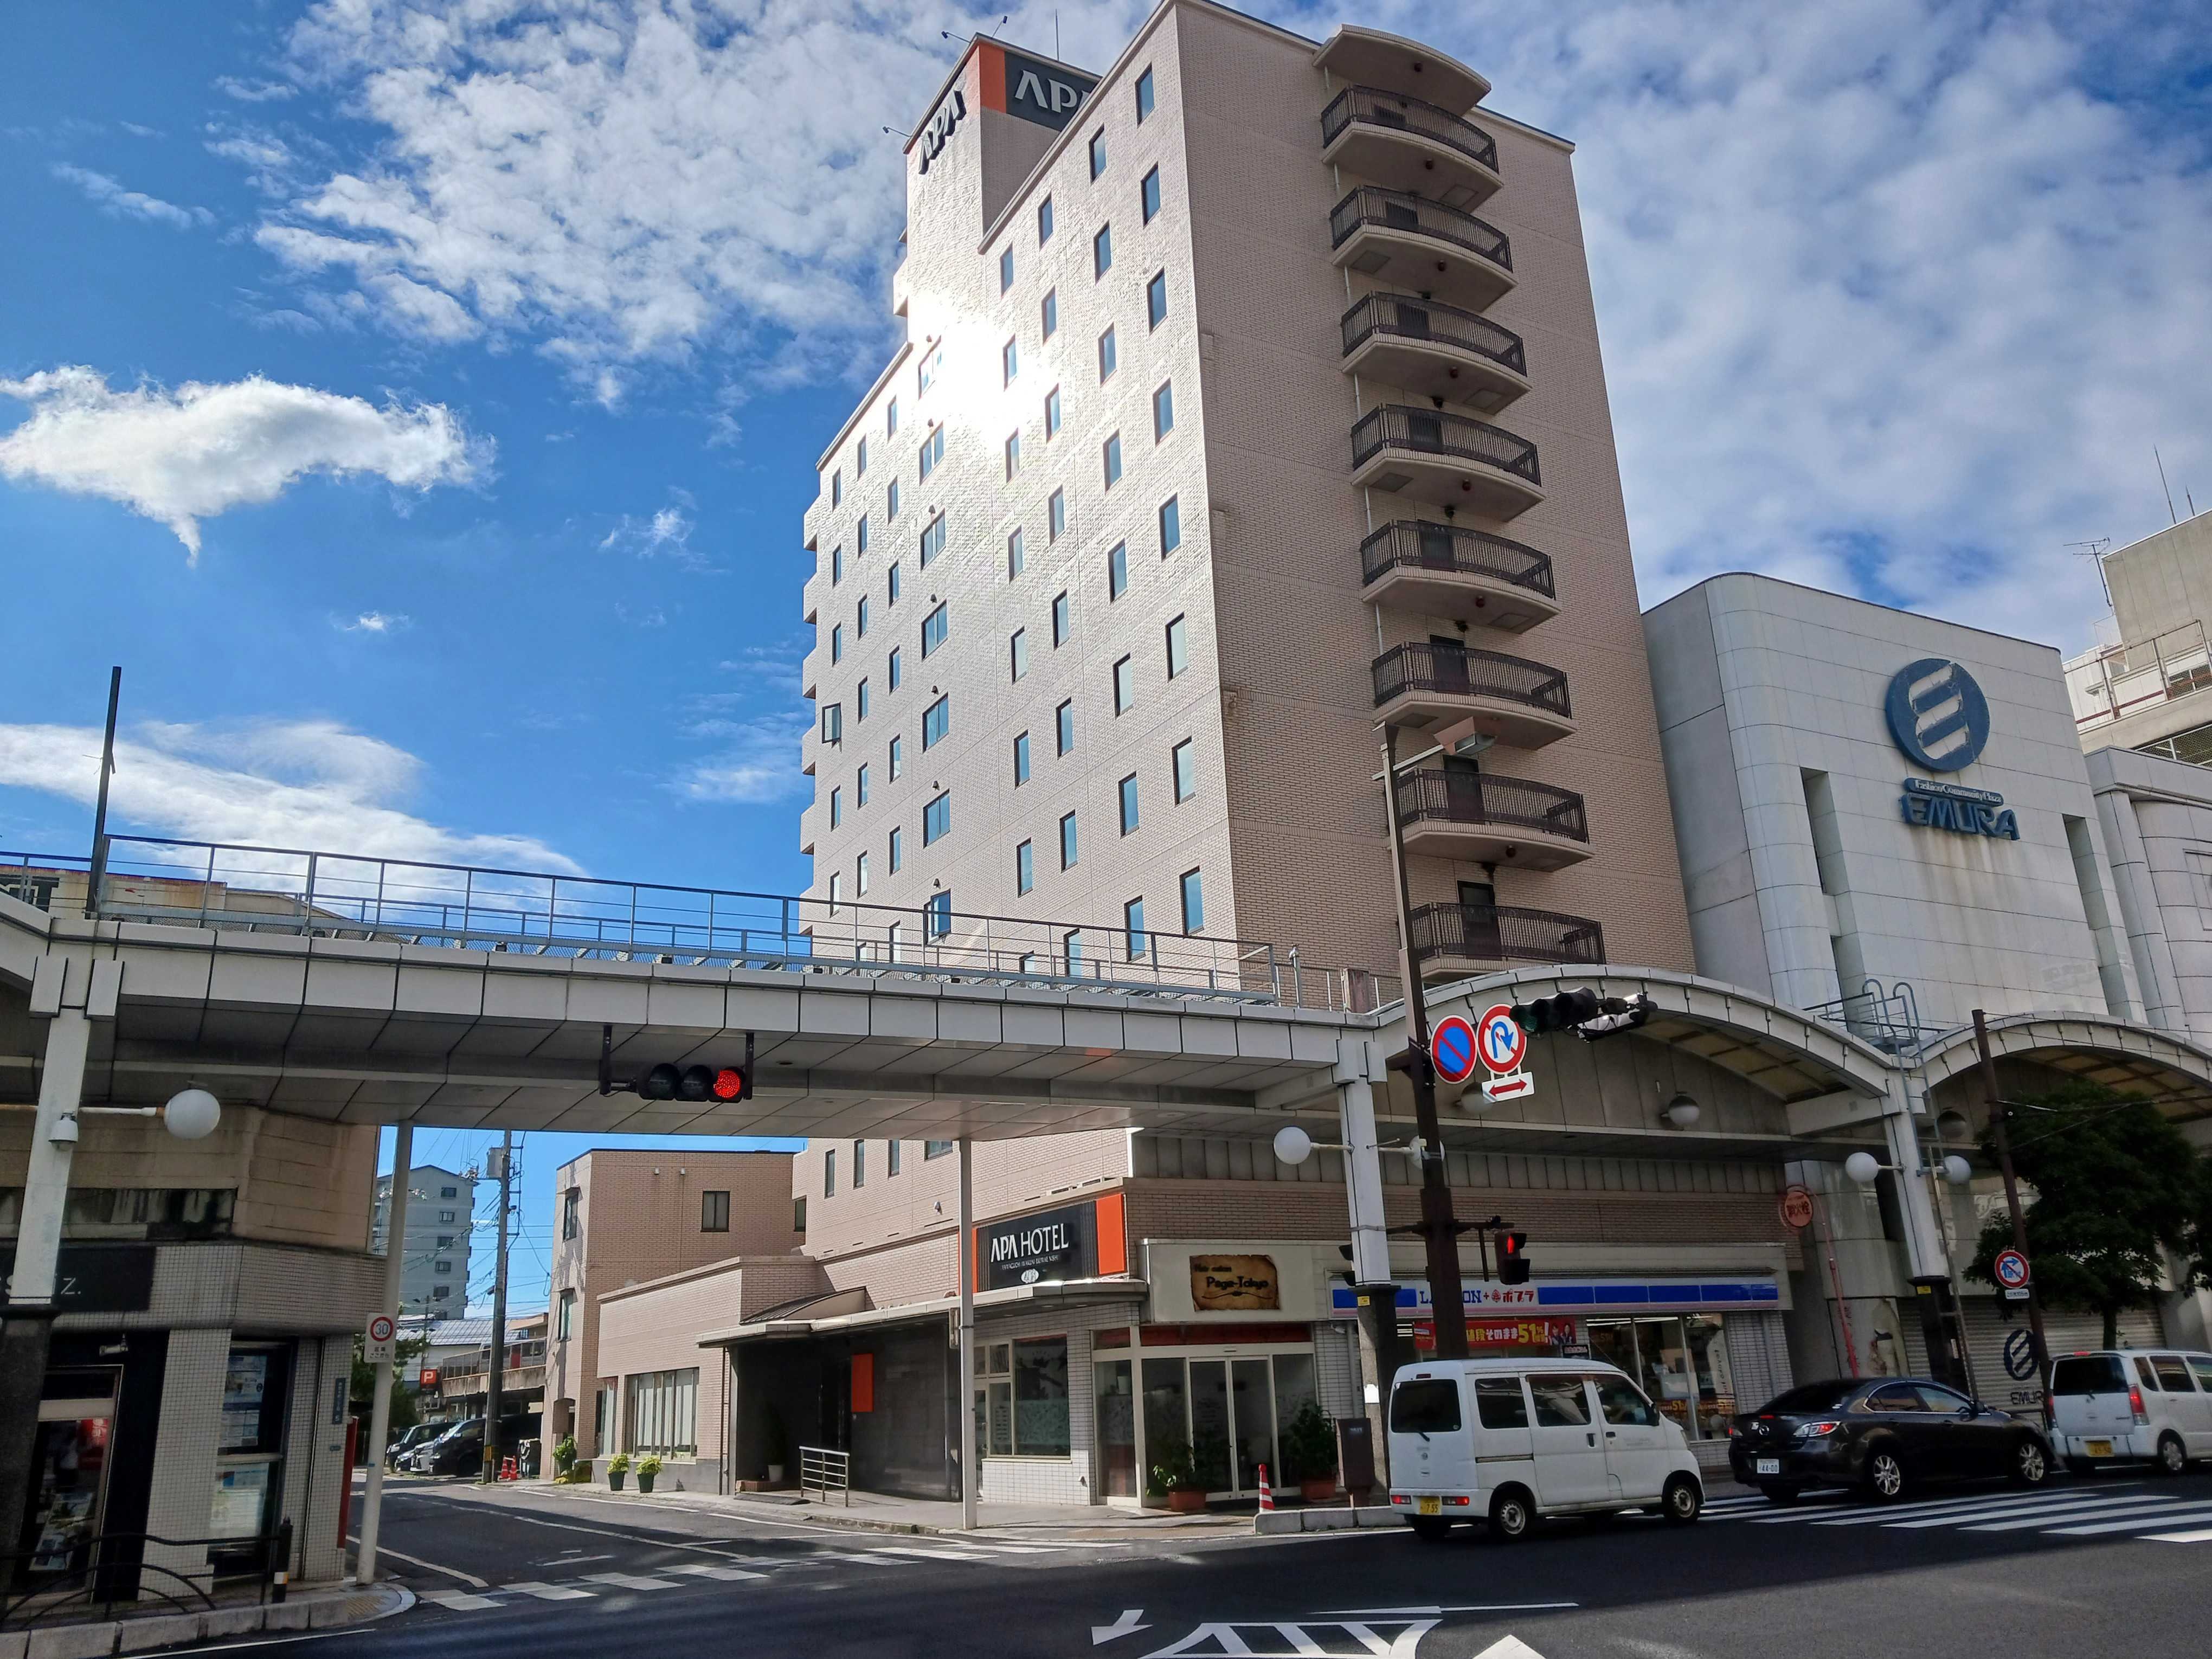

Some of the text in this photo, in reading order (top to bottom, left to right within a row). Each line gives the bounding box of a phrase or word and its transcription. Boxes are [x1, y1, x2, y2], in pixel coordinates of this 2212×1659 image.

[918, 89, 964, 175] APA
[1902, 793, 2020, 840] EMURA
[991, 1234, 1018, 1263] APA
[1020, 1223, 1069, 1257] HOTEL
[1419, 1290, 1482, 1304] LON
[1503, 1288, 1534, 1302] ポプラ
[375, 1323, 389, 1335] 30
[424, 1371, 433, 1383] P
[2010, 1391, 2044, 1405] EMUR
